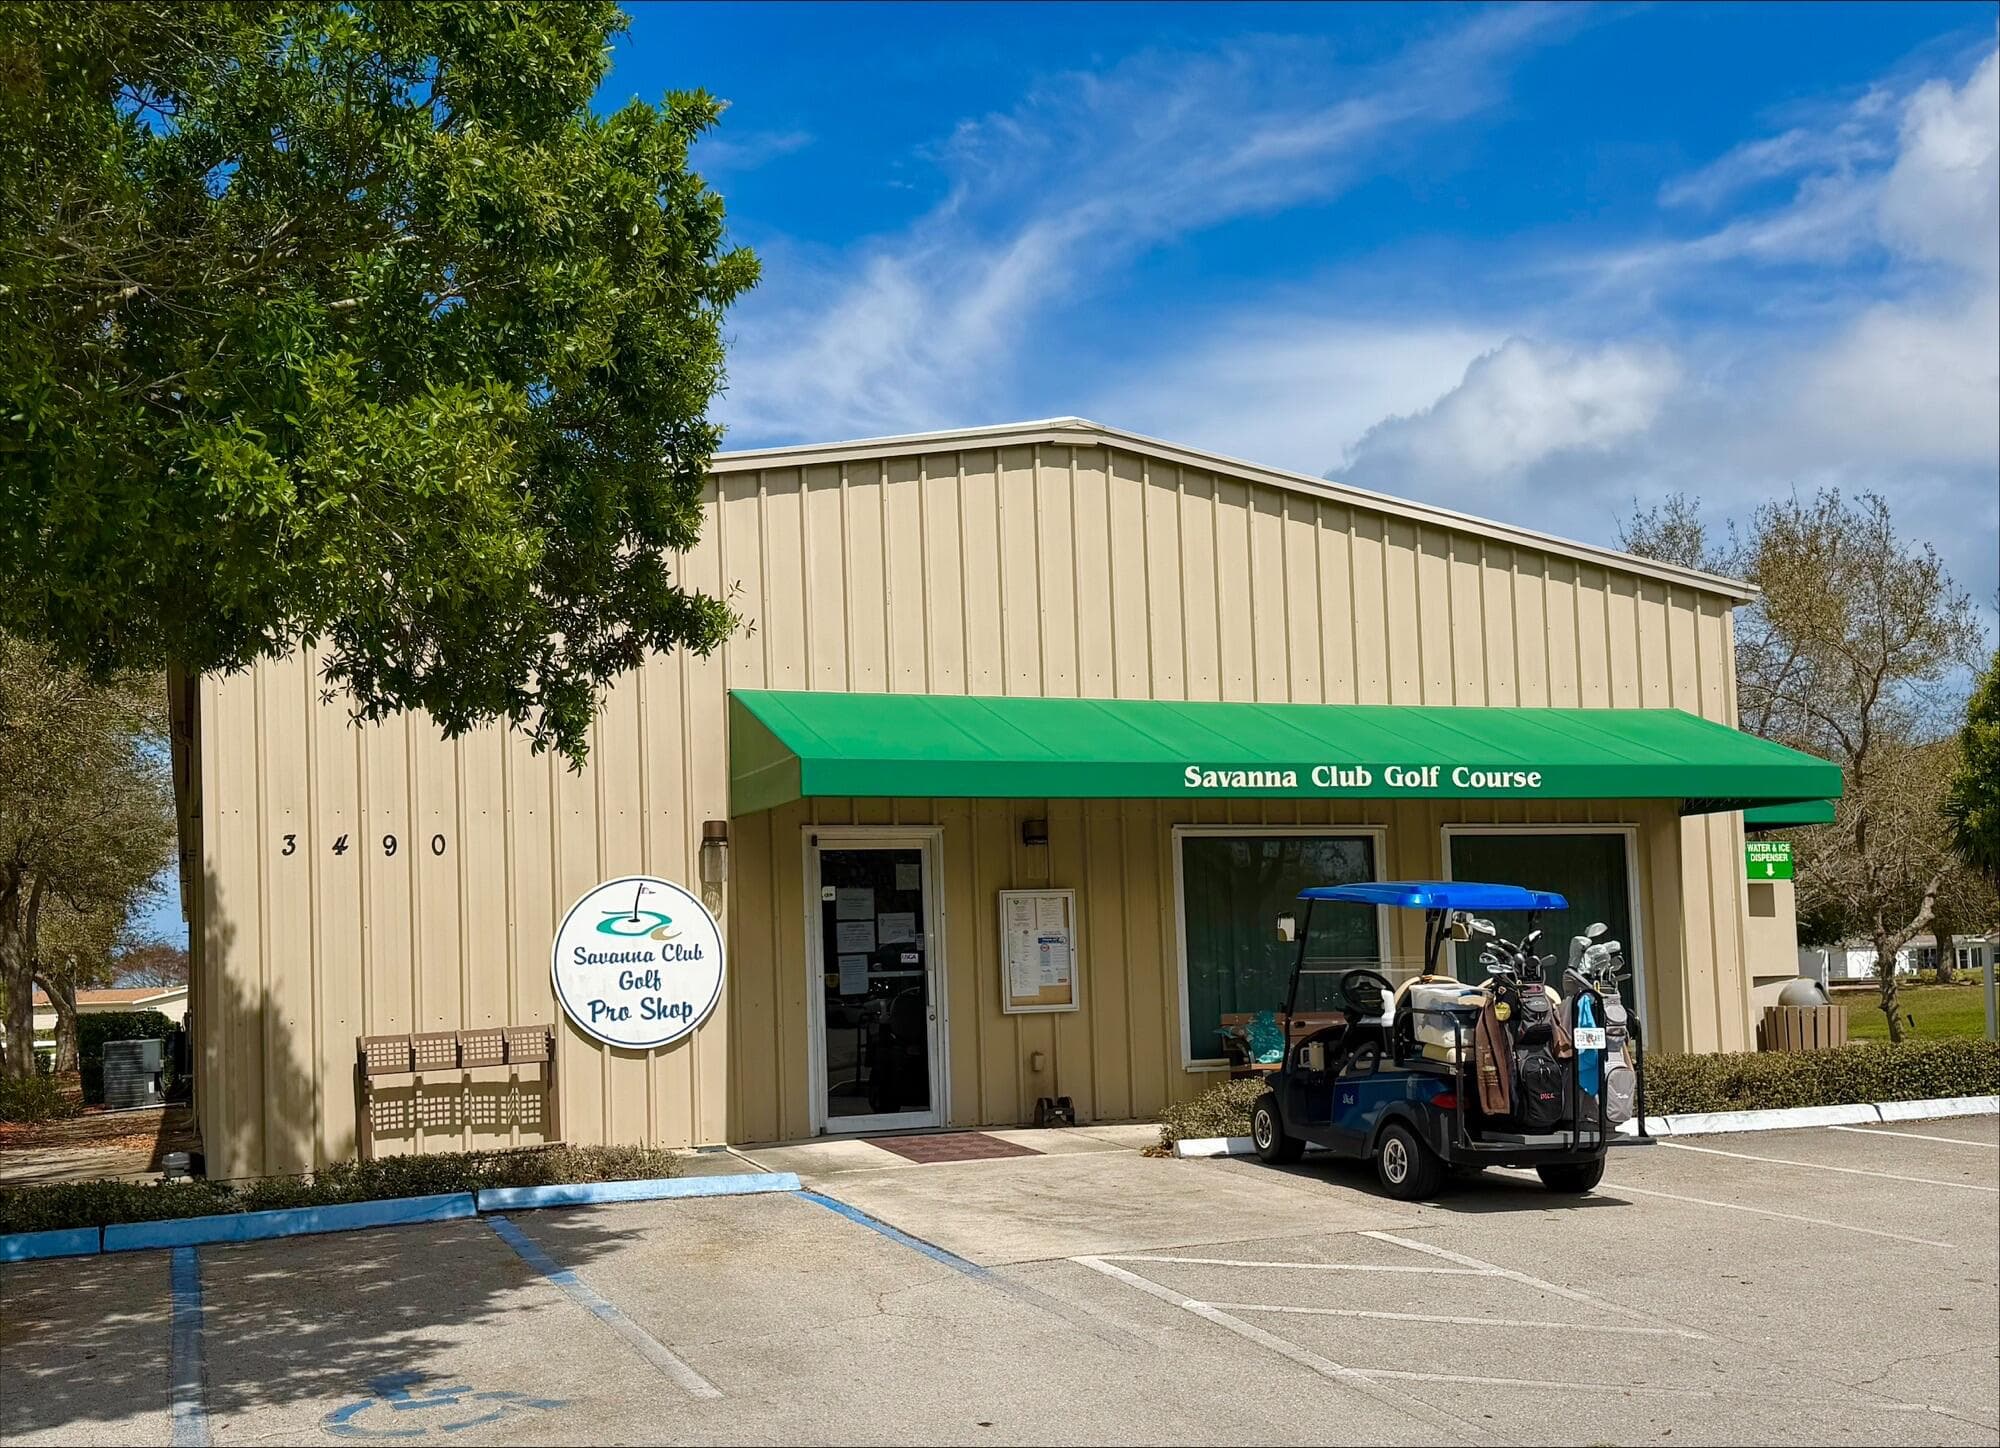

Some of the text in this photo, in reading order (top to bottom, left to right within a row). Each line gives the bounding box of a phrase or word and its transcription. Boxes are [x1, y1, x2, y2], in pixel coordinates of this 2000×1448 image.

[1184, 765, 1543, 788] Savanna Club Golf Course
[1747, 843, 1771, 852] WATER
[1778, 843, 1790, 852] ICE
[1750, 853, 1788, 862] DISPENSER
[573, 943, 704, 966] Savanna Club
[618, 969, 662, 991] Golf
[587, 997, 693, 1024] Pro Shop
